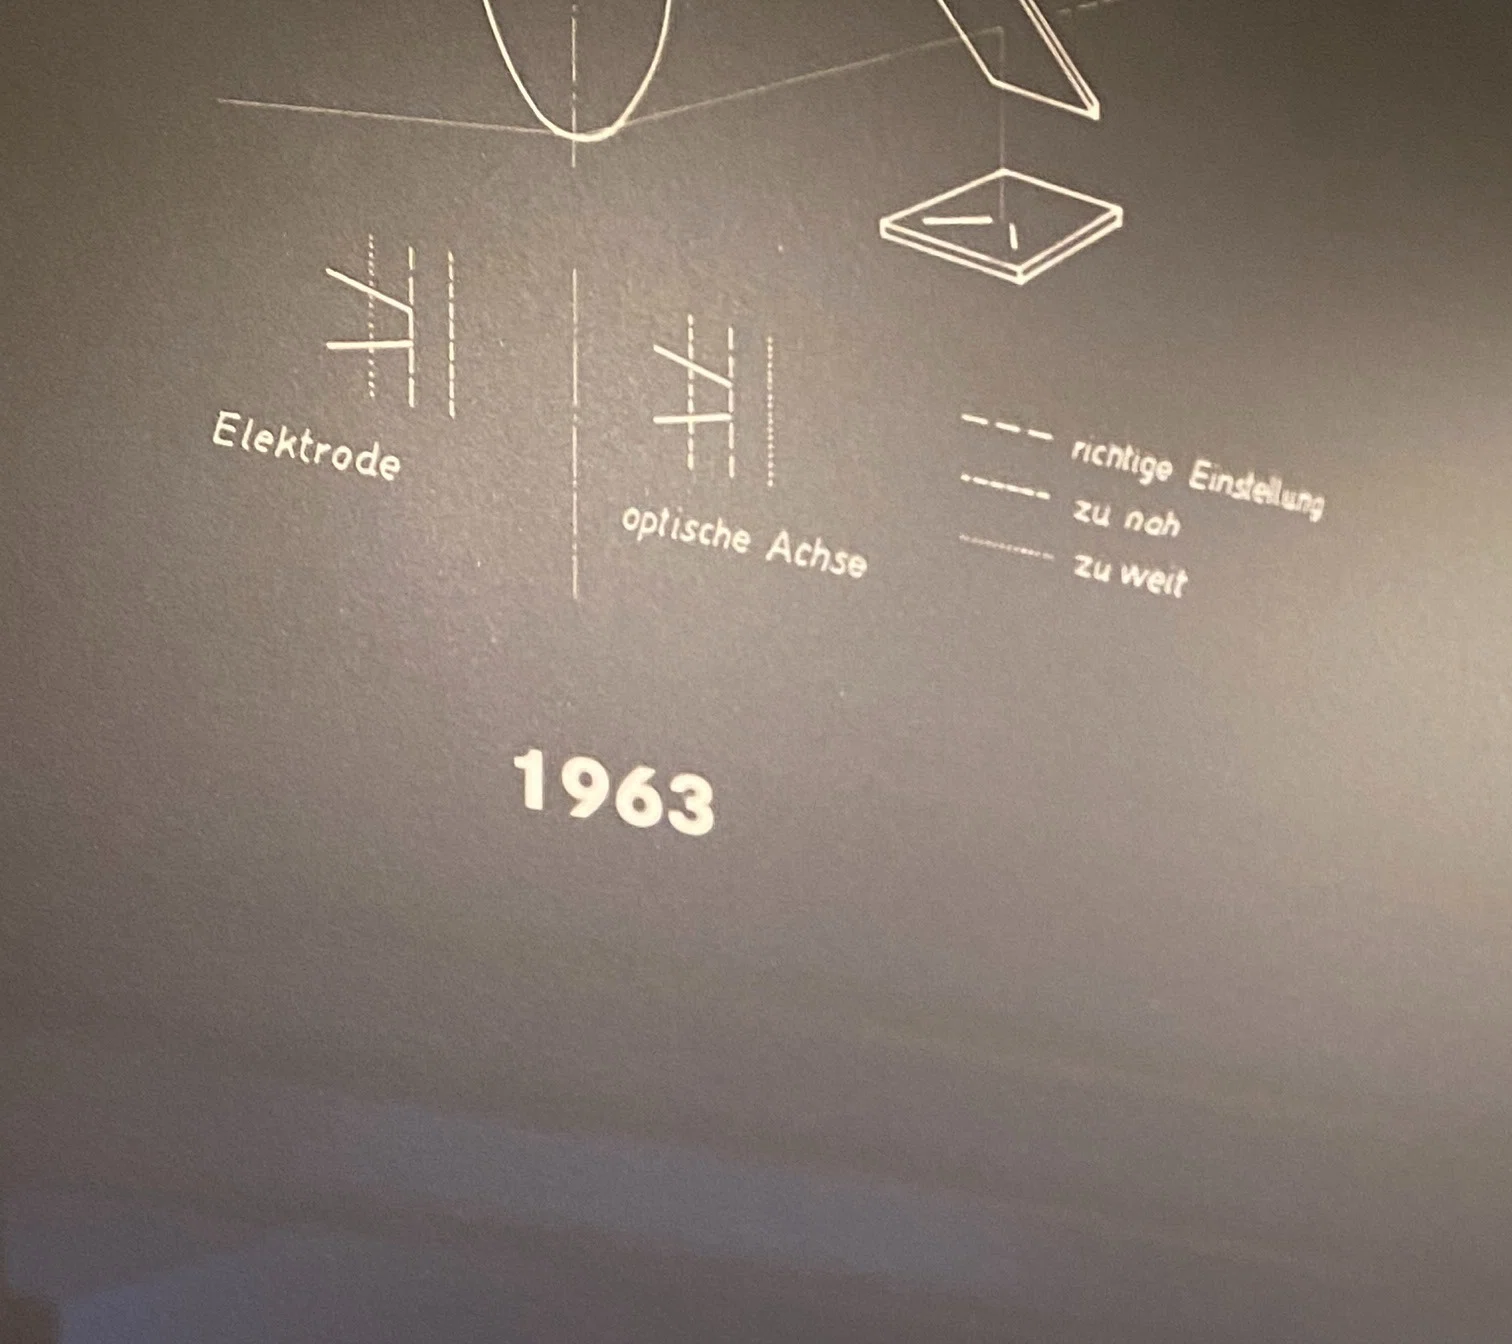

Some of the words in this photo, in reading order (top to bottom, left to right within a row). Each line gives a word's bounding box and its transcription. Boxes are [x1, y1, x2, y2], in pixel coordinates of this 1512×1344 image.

[212, 409, 402, 480] Elektrode
[1071, 438, 1173, 485] richtige
[1188, 458, 1326, 522] Einstellung
[621, 505, 752, 556] optische
[766, 531, 868, 579] Achse
[1073, 500, 1110, 528] zu
[1074, 554, 1111, 583] zu
[1120, 561, 1189, 599] weit
[513, 748, 715, 836] 1963
